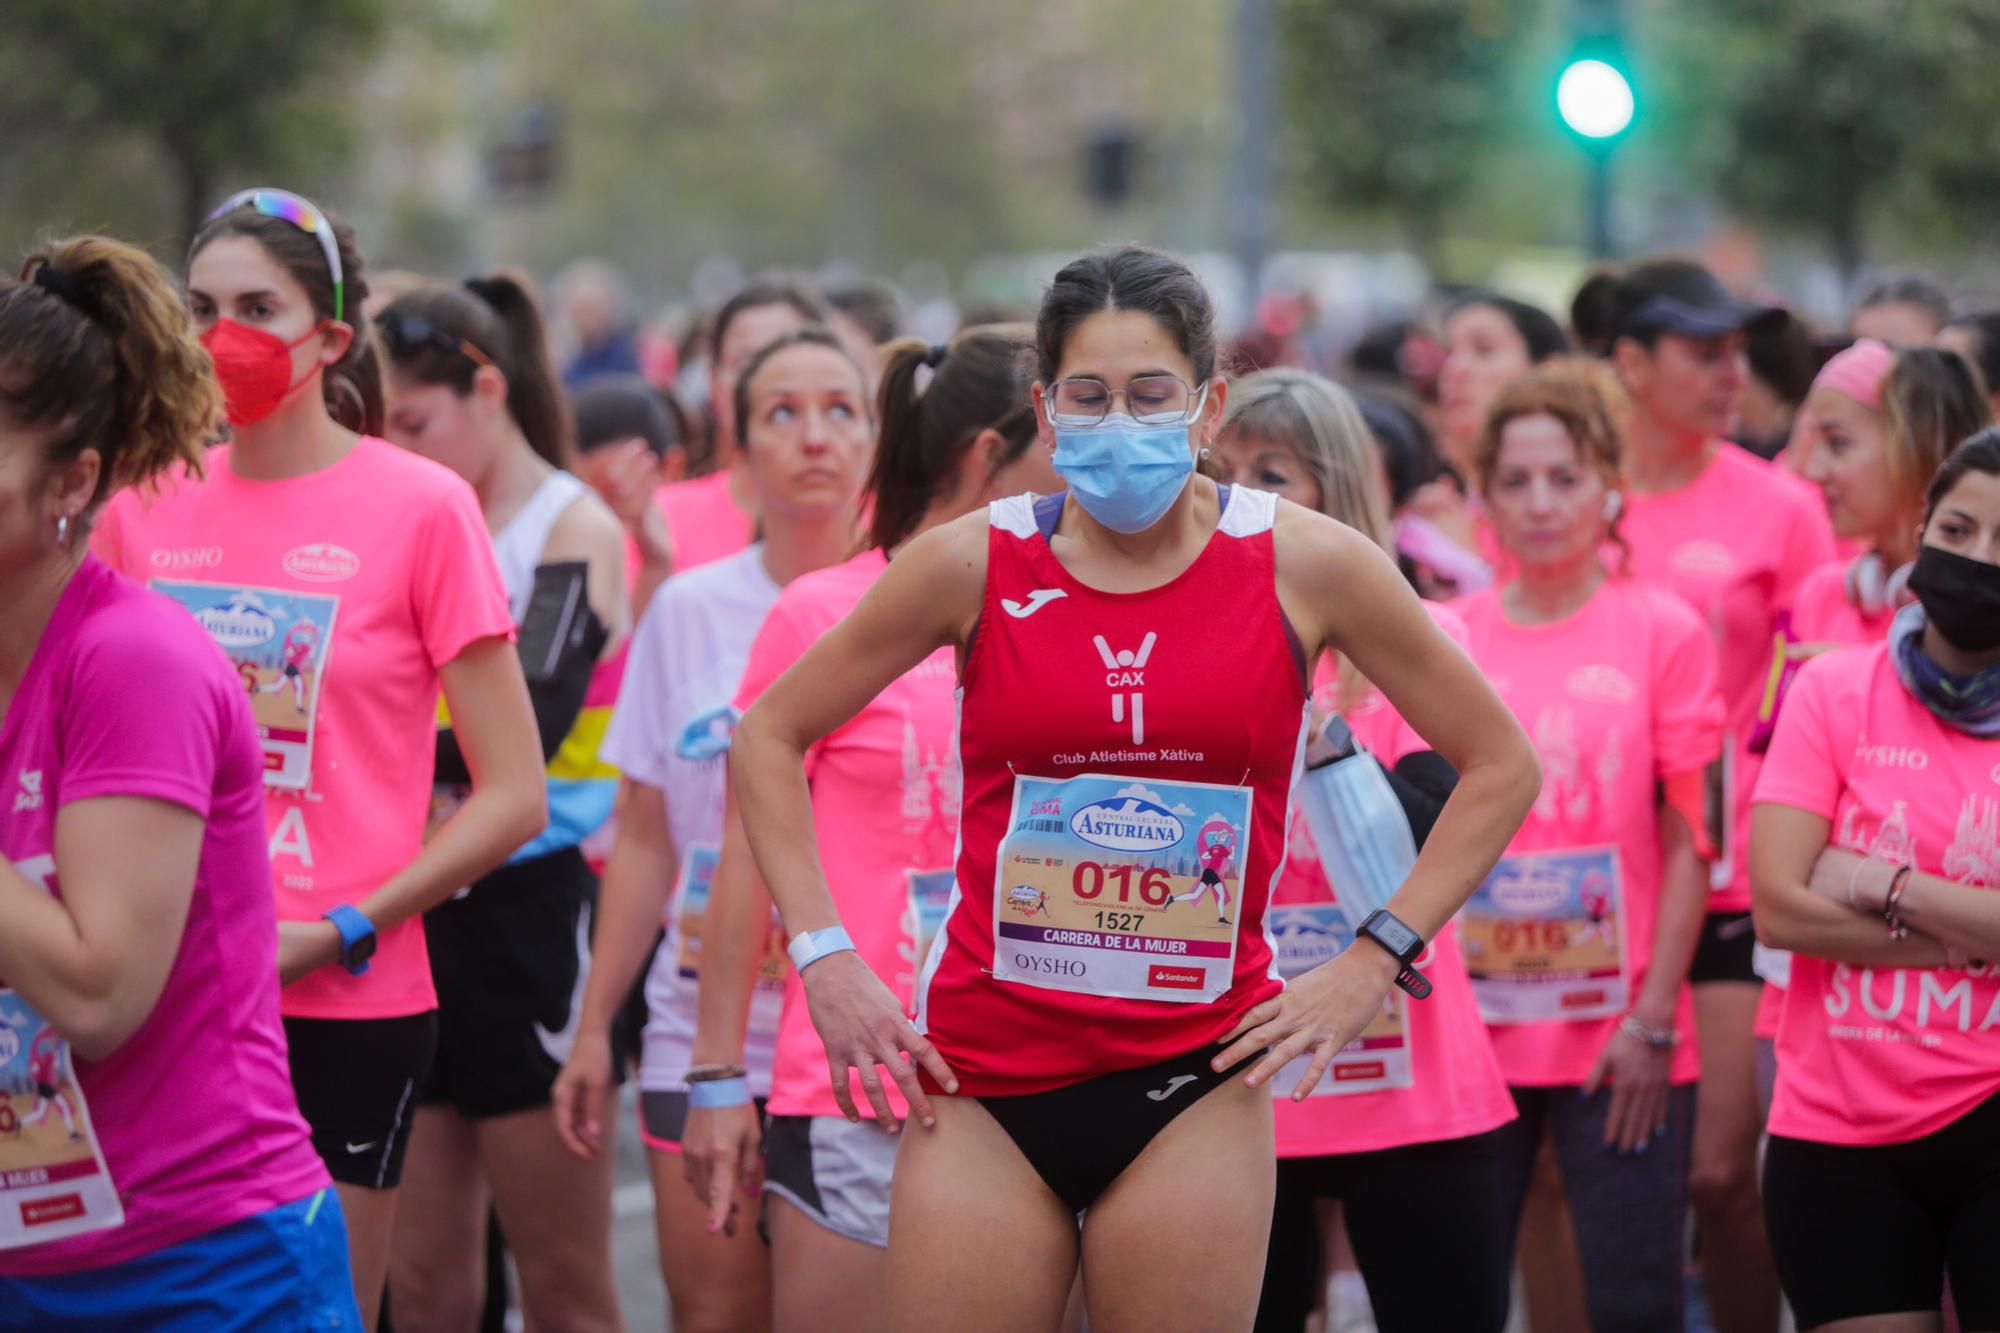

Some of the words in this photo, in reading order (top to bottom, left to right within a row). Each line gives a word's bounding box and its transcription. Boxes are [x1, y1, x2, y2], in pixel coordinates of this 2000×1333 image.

[1106, 672, 1144, 687] CAX
[1052, 752, 1086, 765] Club
[1089, 750, 1157, 763] Atletisme
[1160, 748, 1204, 762] Xàtiva
[1078, 813, 1176, 841] ASTURIANA
[1072, 861, 1172, 906] 016
[1095, 911, 1145, 932] 1527
[1043, 929, 1101, 946] CARRERA
[1104, 935, 1122, 948] DE
[1125, 937, 1141, 950] LA
[1144, 939, 1187, 954] MUJER
[1015, 953, 1086, 977] OYSHO
[1164, 973, 1200, 983] Santander
